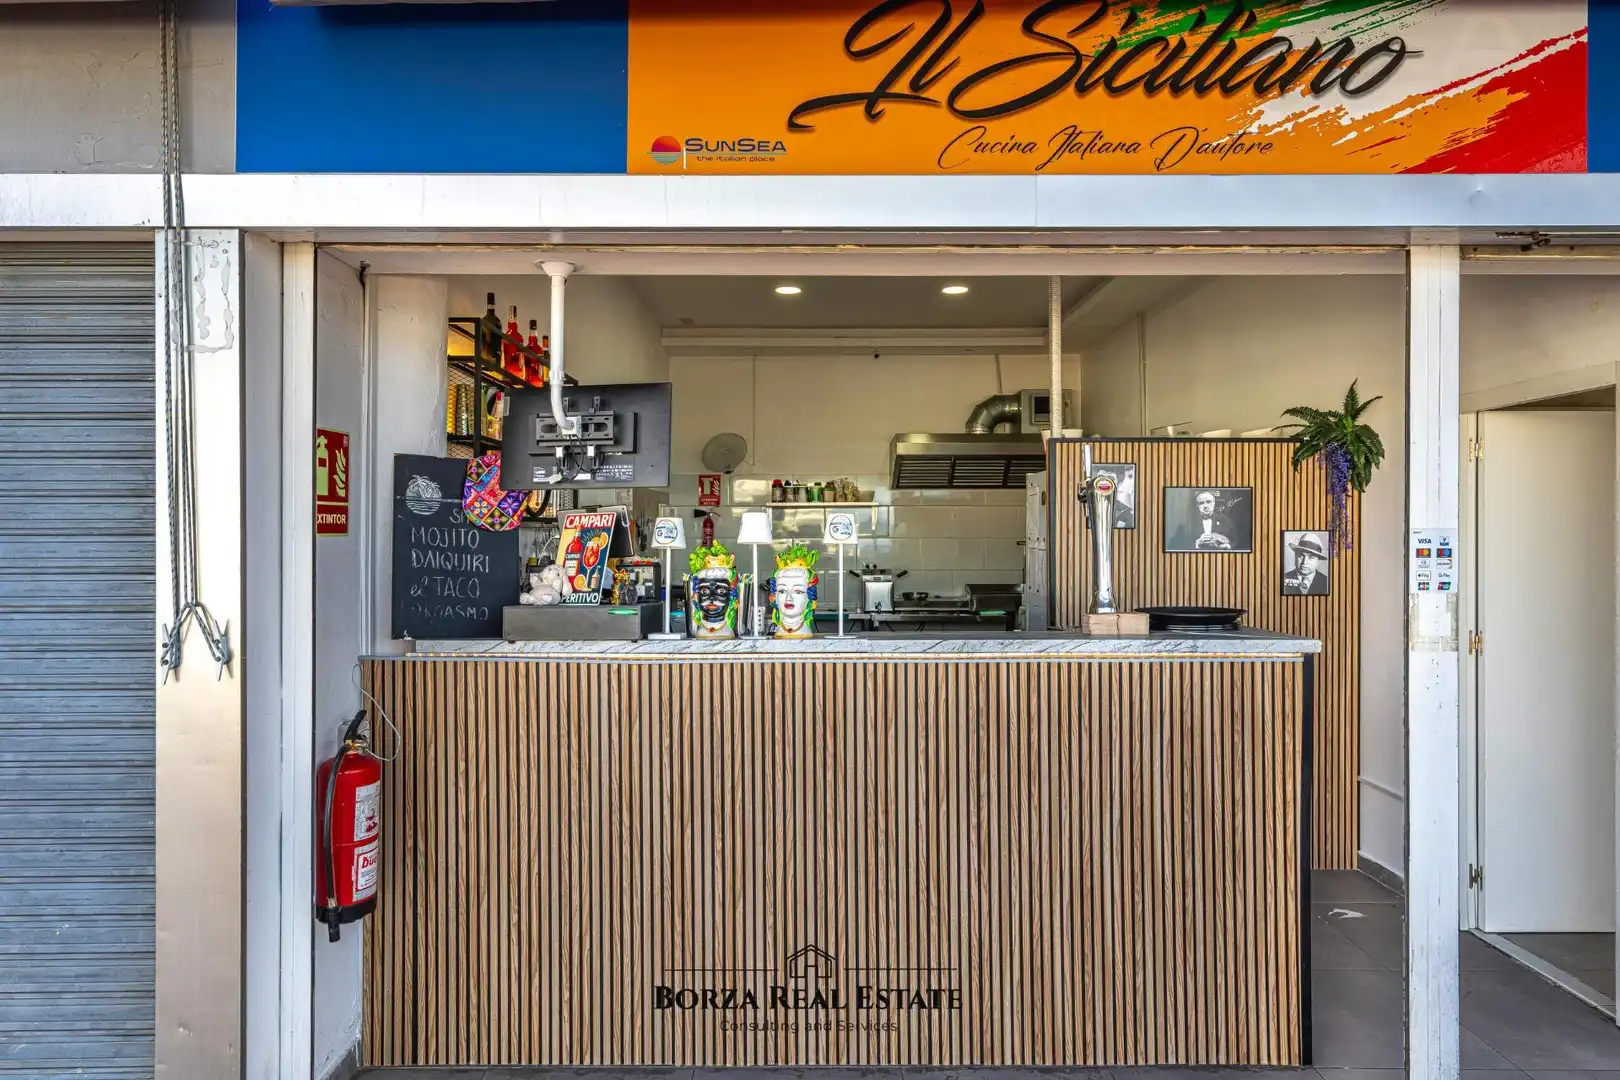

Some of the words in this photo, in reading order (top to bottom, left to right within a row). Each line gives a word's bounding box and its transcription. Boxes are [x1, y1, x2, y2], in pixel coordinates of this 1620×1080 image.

[946, 0, 1424, 119] Siciliano
[749, 155, 776, 163] place
[937, 125, 1039, 170] Cucina
[1035, 124, 1142, 171] Italiana
[316, 513, 347, 525] XTINTOR
[565, 514, 614, 529] CAMPARI
[411, 526, 480, 549] MOJITO
[411, 548, 490, 573] DAIQUIRI
[432, 576, 481, 600] TACO
[560, 592, 599, 604] PERITIVO
